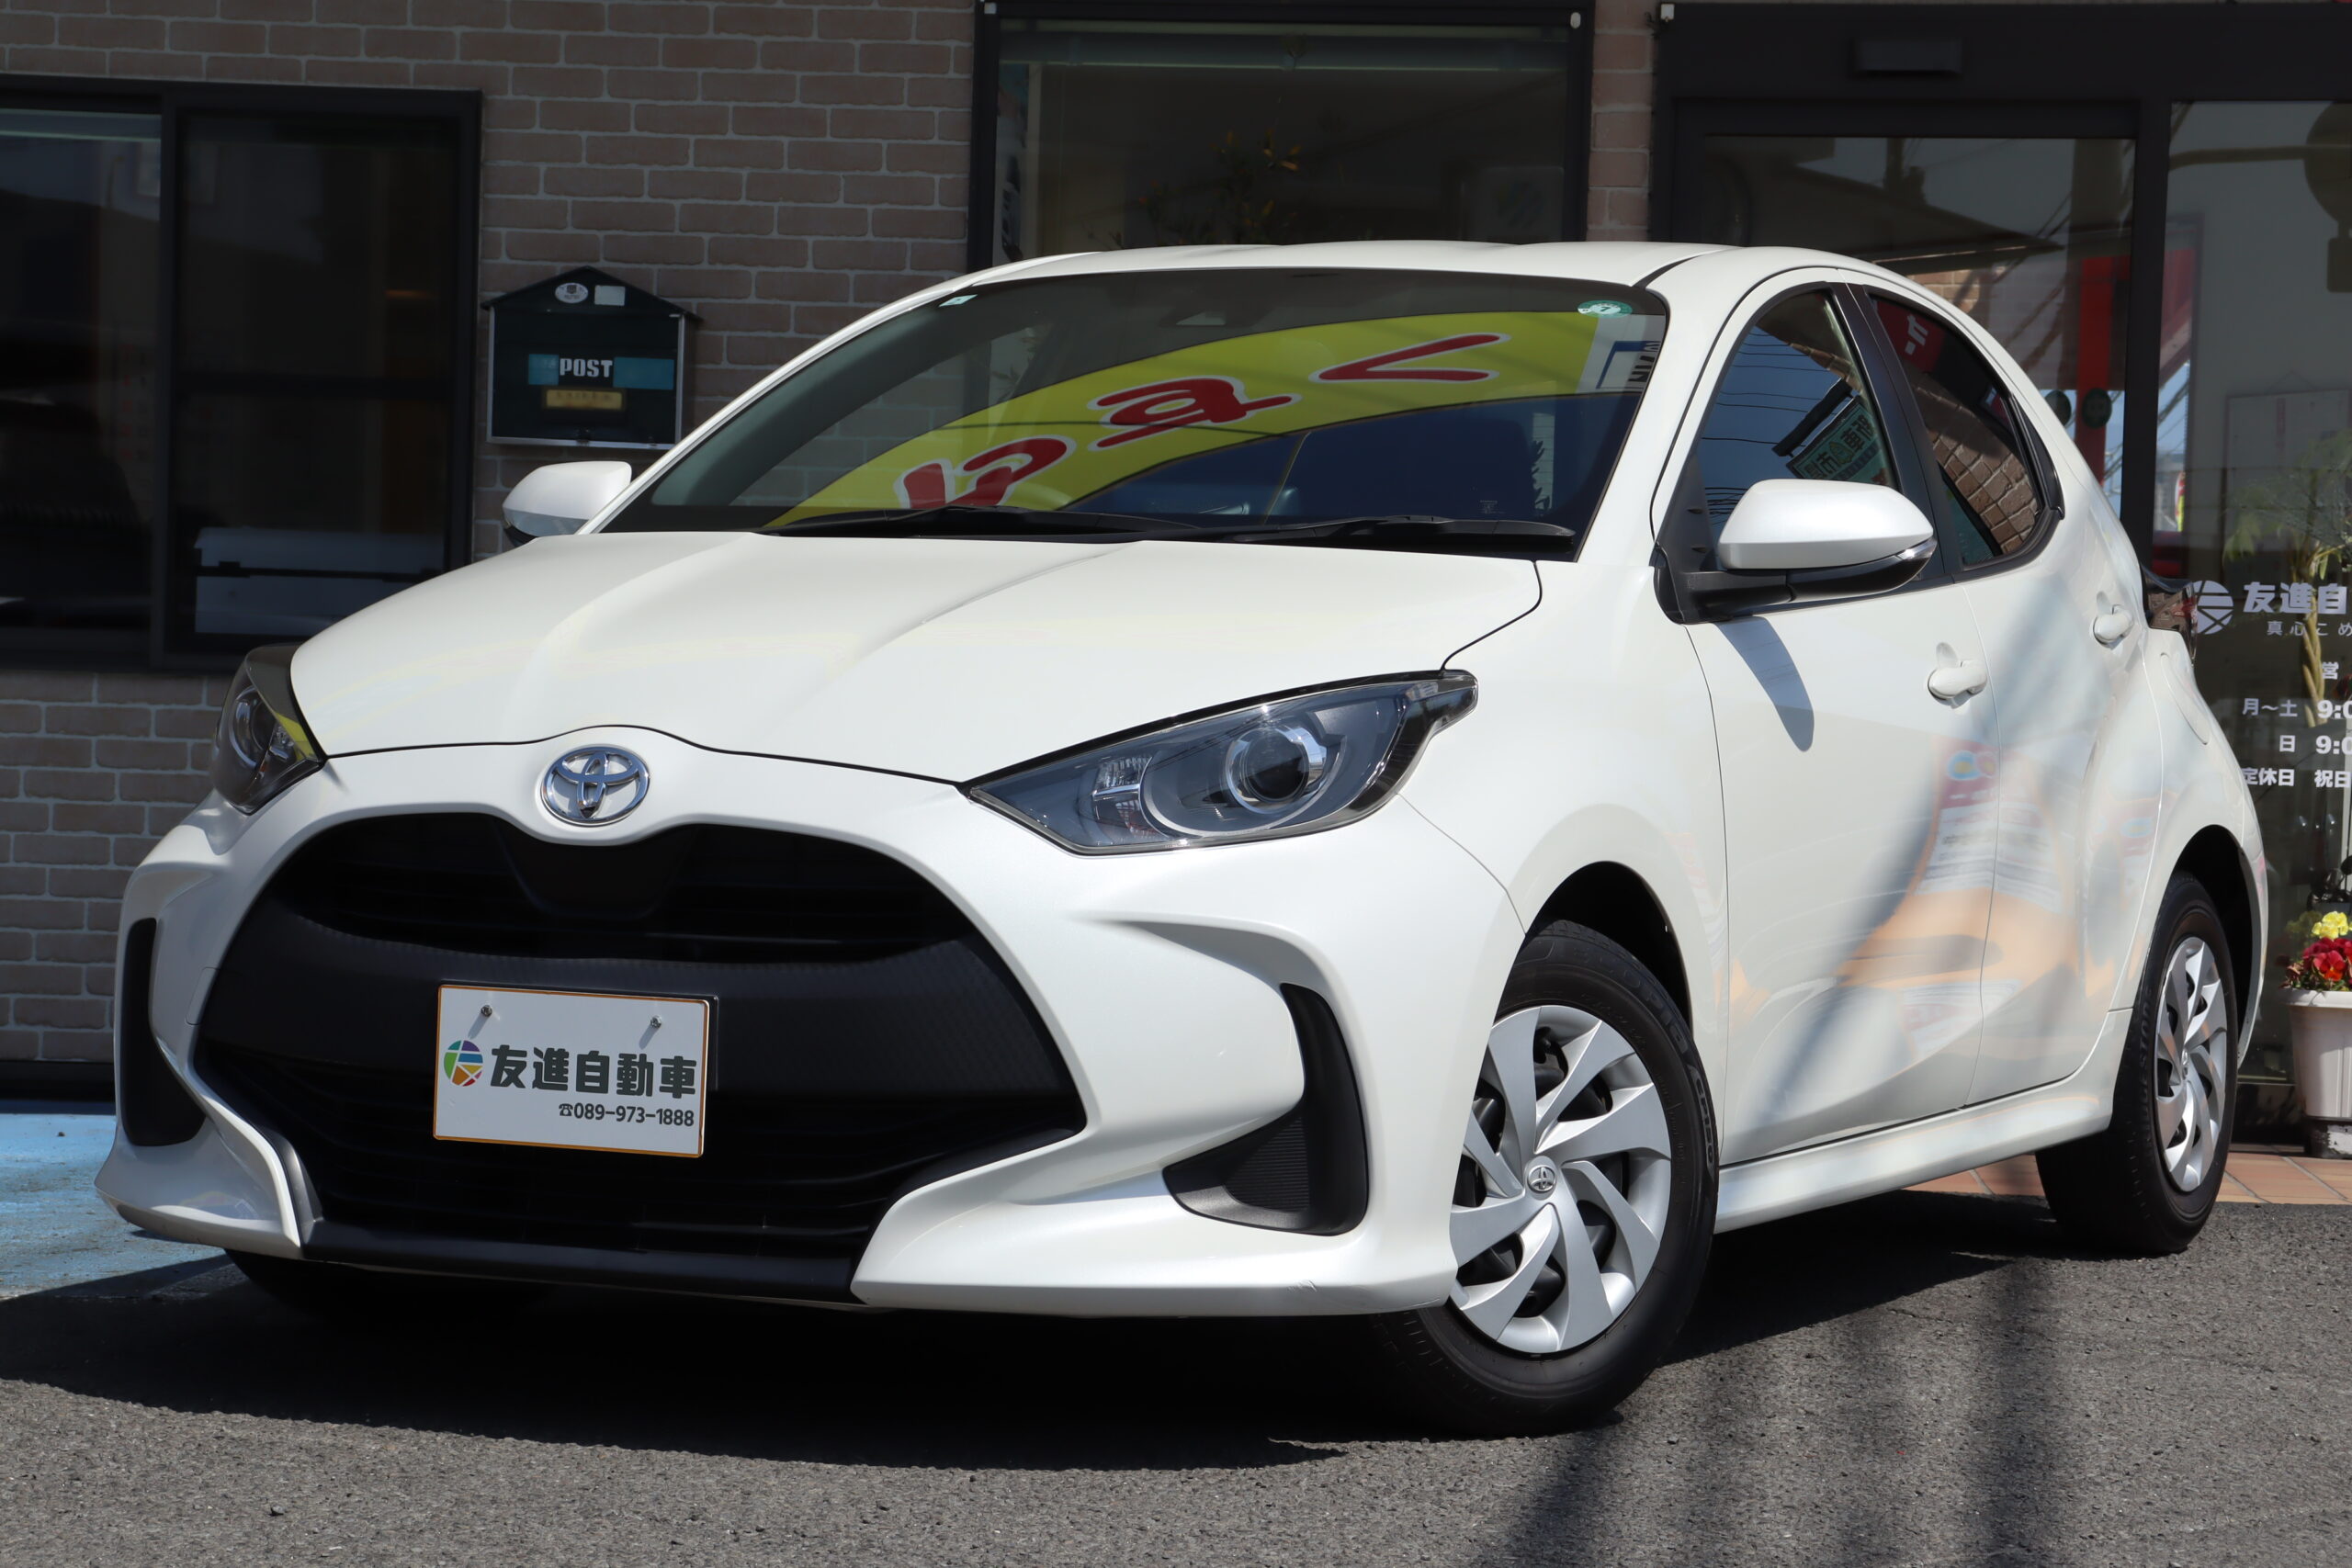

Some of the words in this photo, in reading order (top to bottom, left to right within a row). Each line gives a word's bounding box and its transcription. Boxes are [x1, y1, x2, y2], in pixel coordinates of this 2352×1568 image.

[560, 358, 613, 378] POST
[2243, 581, 2347, 615] 友進自
[2279, 735, 2295, 752] 日
[2241, 767, 2295, 787] 定休日
[490, 1044, 697, 1099] 友進自動車
